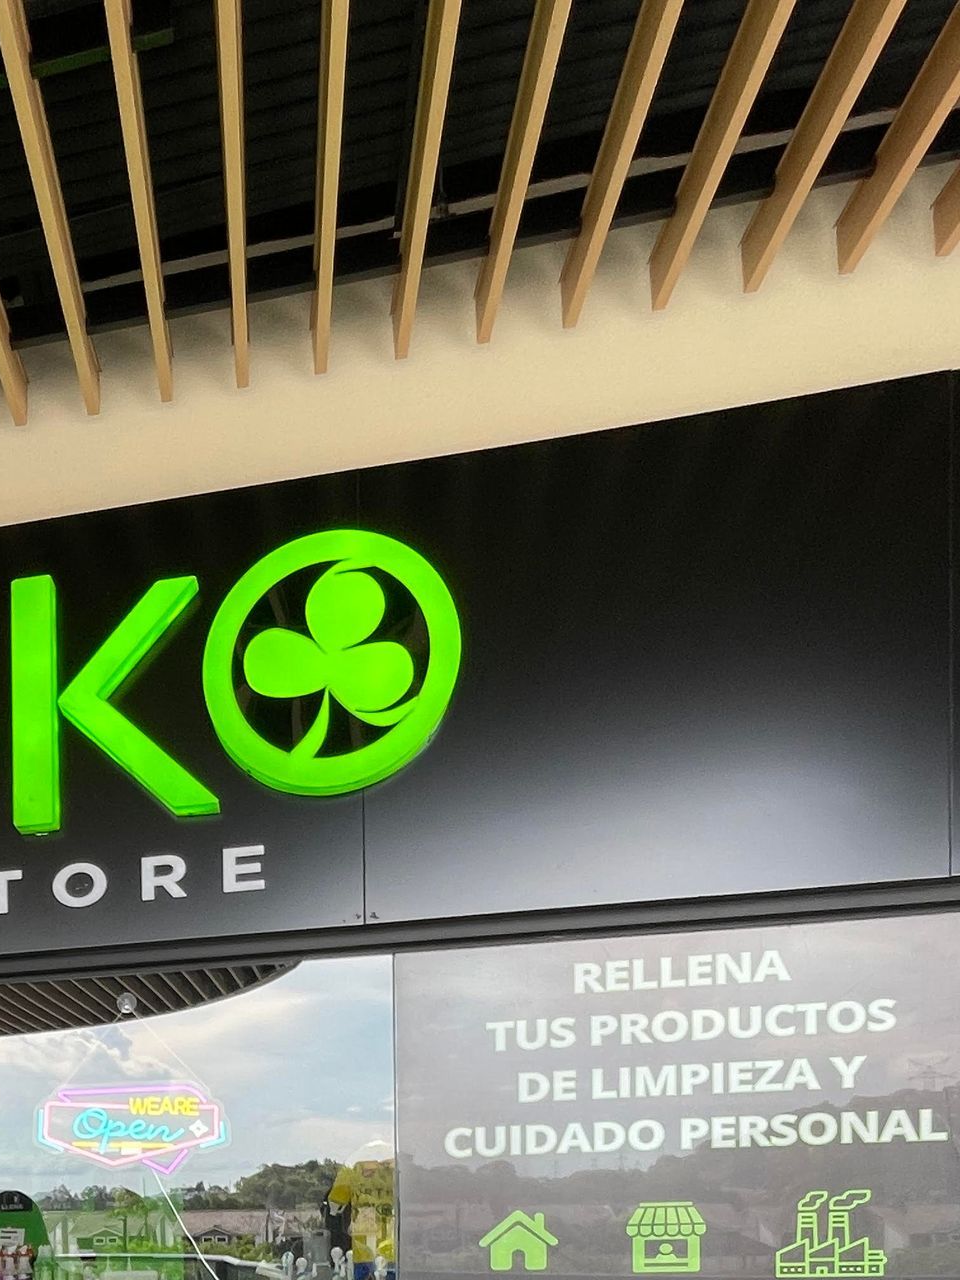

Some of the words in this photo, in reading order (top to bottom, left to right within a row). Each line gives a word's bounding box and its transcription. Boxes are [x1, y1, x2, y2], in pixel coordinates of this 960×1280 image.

[573, 949, 792, 994] RELLENA
[486, 1017, 576, 1053] TUS
[590, 998, 897, 1047] PRODUCTOS
[518, 1070, 577, 1103] DE
[592, 1058, 821, 1100] LIMPIEZA
[829, 1055, 867, 1089] Y
[72, 1107, 185, 1154] Open
[444, 1119, 665, 1159] CUIDADO
[681, 1108, 949, 1150] PERSONAL
